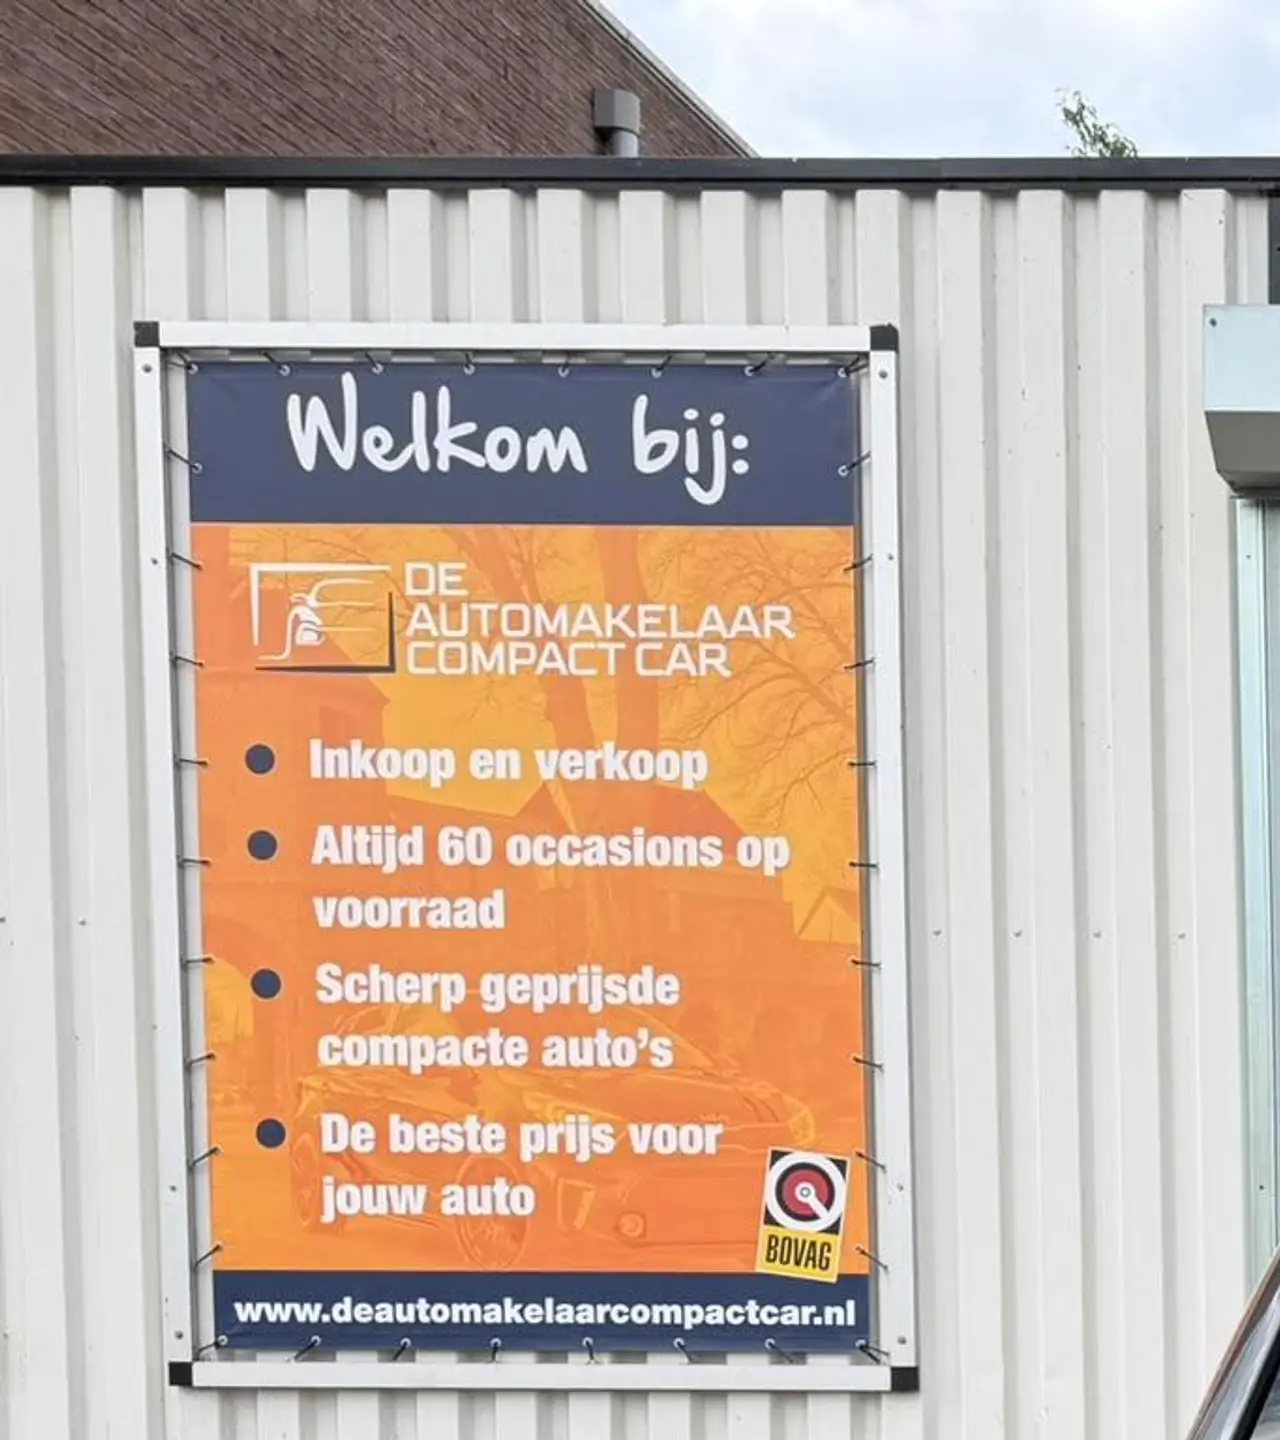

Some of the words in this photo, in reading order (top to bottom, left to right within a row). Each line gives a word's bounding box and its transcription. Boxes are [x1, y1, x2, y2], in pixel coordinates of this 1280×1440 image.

[286, 371, 588, 474] Welkom
[632, 394, 750, 506] bij:
[405, 562, 469, 597] DE
[403, 602, 797, 640] AUTOMAKELAAR
[405, 640, 627, 677] COMPACT
[635, 642, 733, 678] CAR
[309, 739, 456, 786] Inkoop
[468, 747, 522, 780] en
[534, 742, 708, 789] verkoop
[310, 824, 424, 873] Altijd
[437, 826, 493, 868] 60
[505, 827, 724, 869] occasions
[735, 836, 790, 876] op
[313, 889, 505, 930] voorraad
[314, 962, 467, 1010] Scherp
[479, 965, 681, 1013] geprijsde
[316, 1030, 528, 1075] compacte
[320, 1112, 376, 1155] De
[388, 1114, 506, 1155] beste
[519, 1115, 616, 1162] prijs
[628, 1122, 724, 1157] voor
[320, 1177, 426, 1224] jouw
[439, 1180, 537, 1217] auto
[765, 1233, 833, 1272] BOVAG
[233, 1297, 856, 1329] www.deautomakelaarcompactcar.nl
